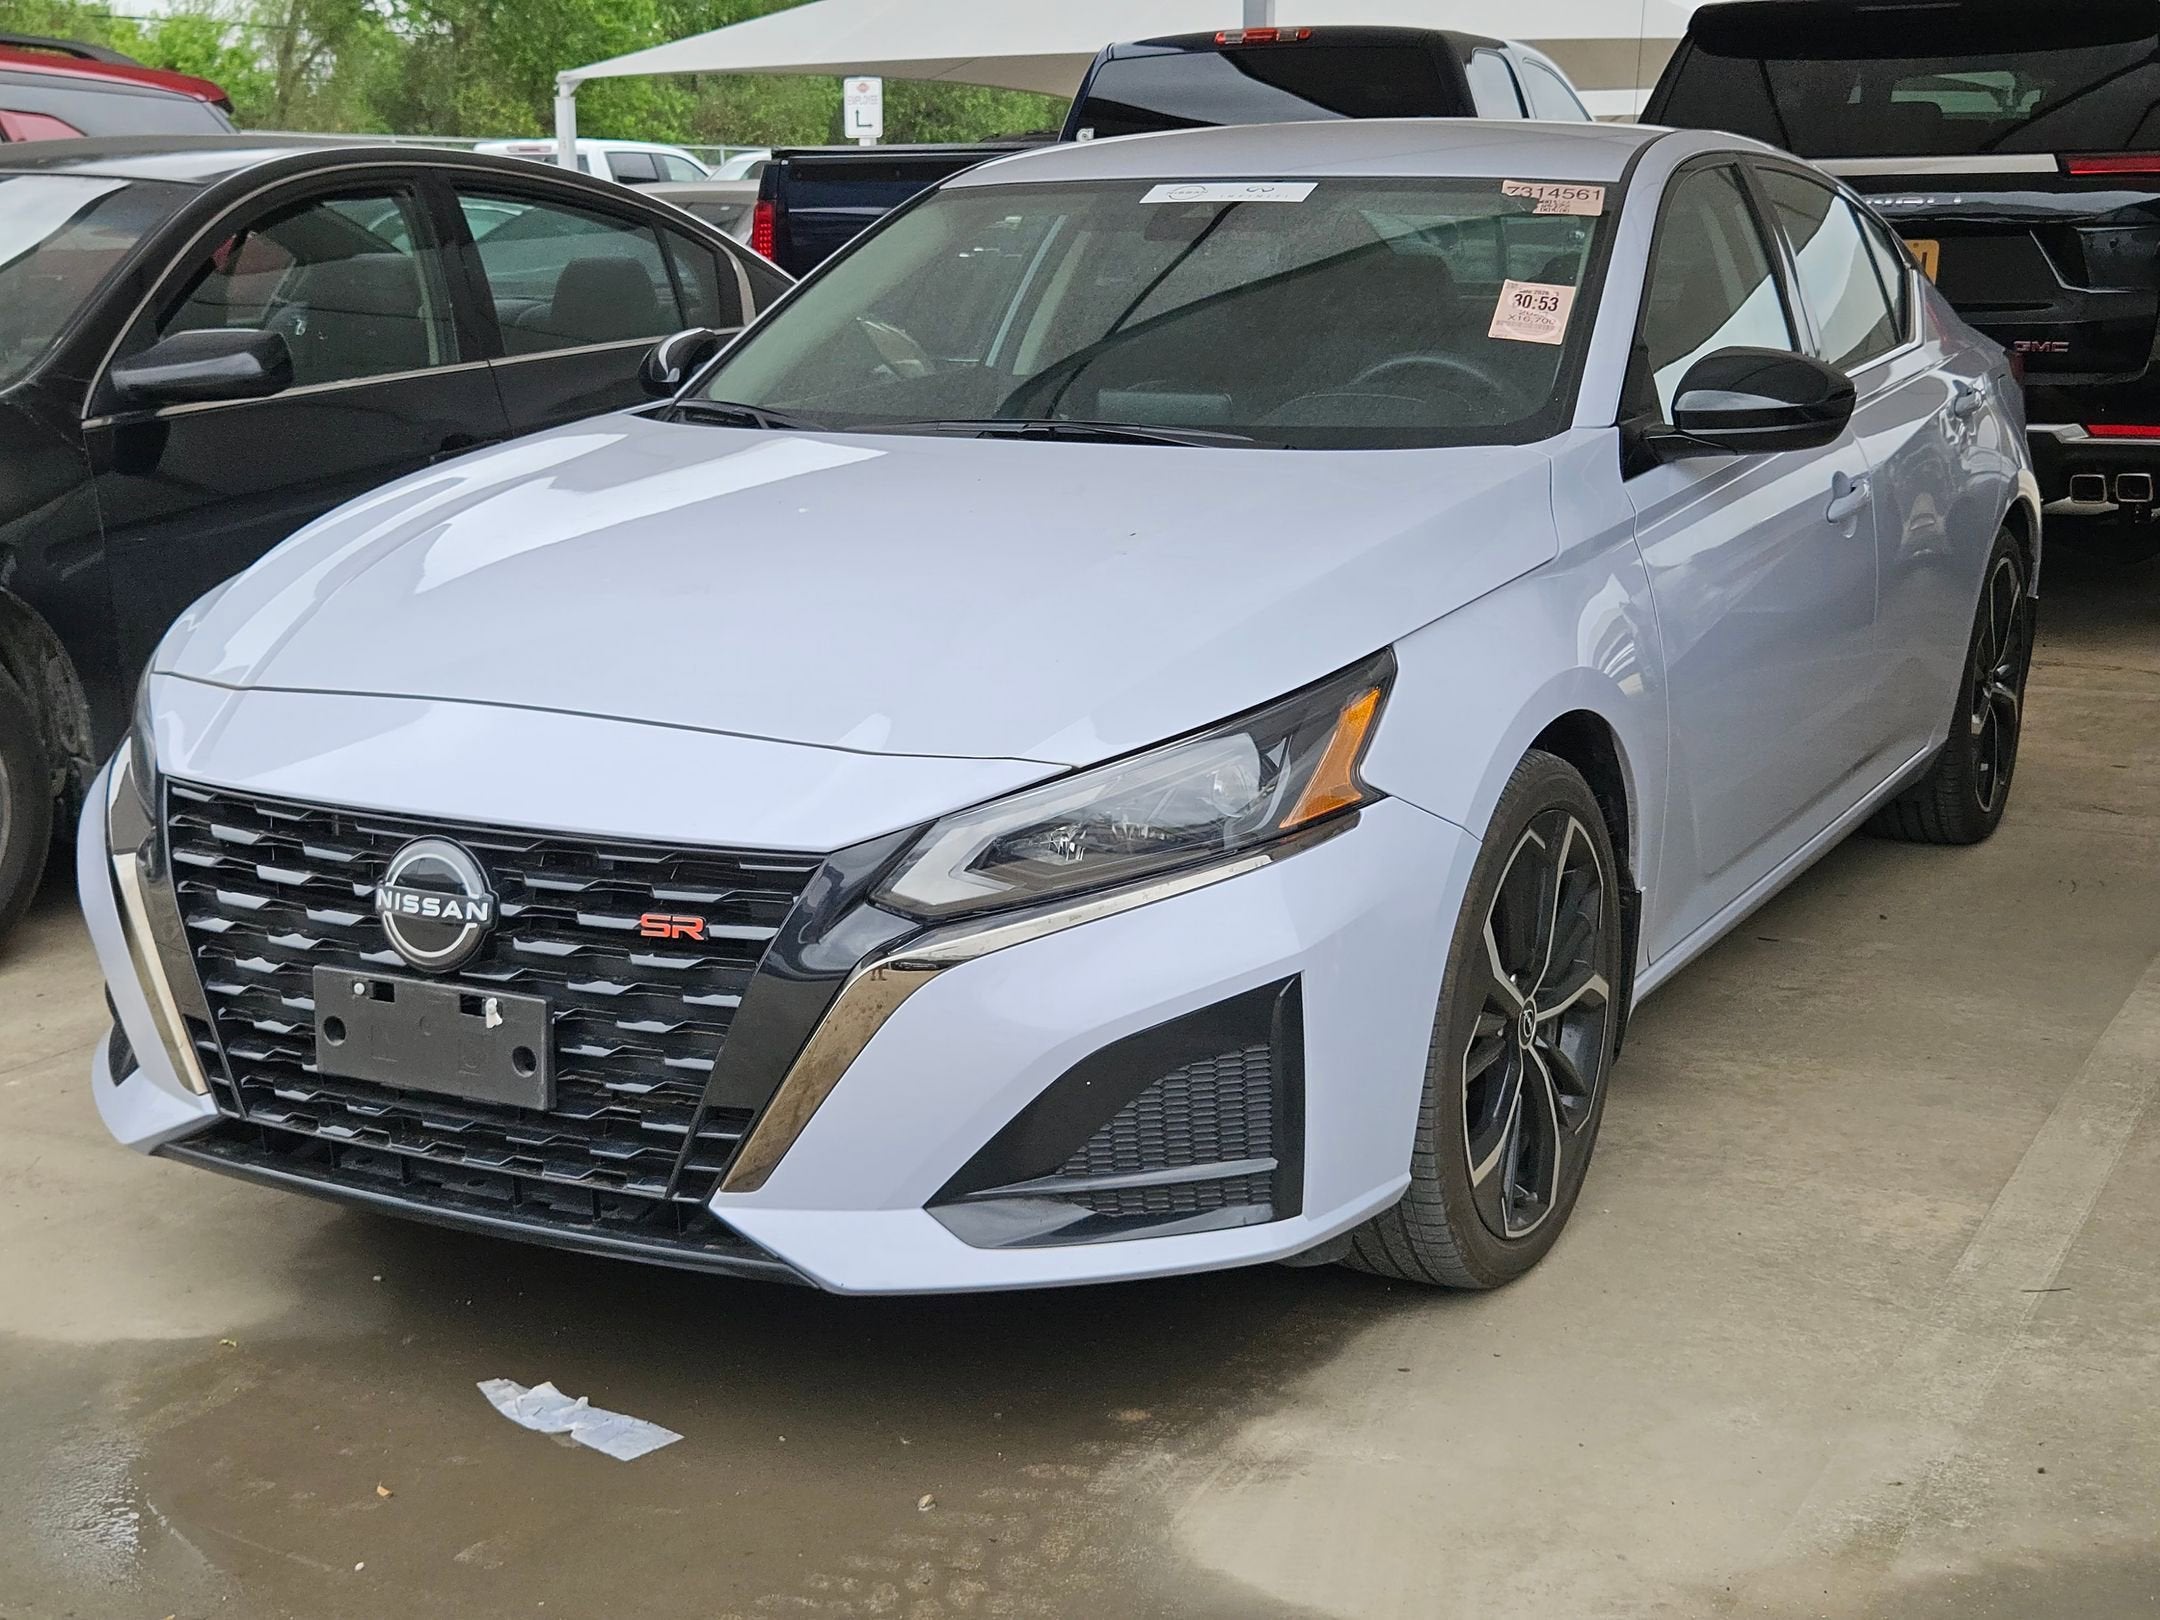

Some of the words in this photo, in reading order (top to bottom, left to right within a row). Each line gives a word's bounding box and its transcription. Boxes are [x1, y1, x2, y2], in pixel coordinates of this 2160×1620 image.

[1506, 186, 1600, 200] 7314561
[1513, 293, 1560, 312] 30:53
[2014, 340, 2070, 353] GMC
[376, 887, 489, 922] NISSAN
[640, 913, 706, 941] SR
